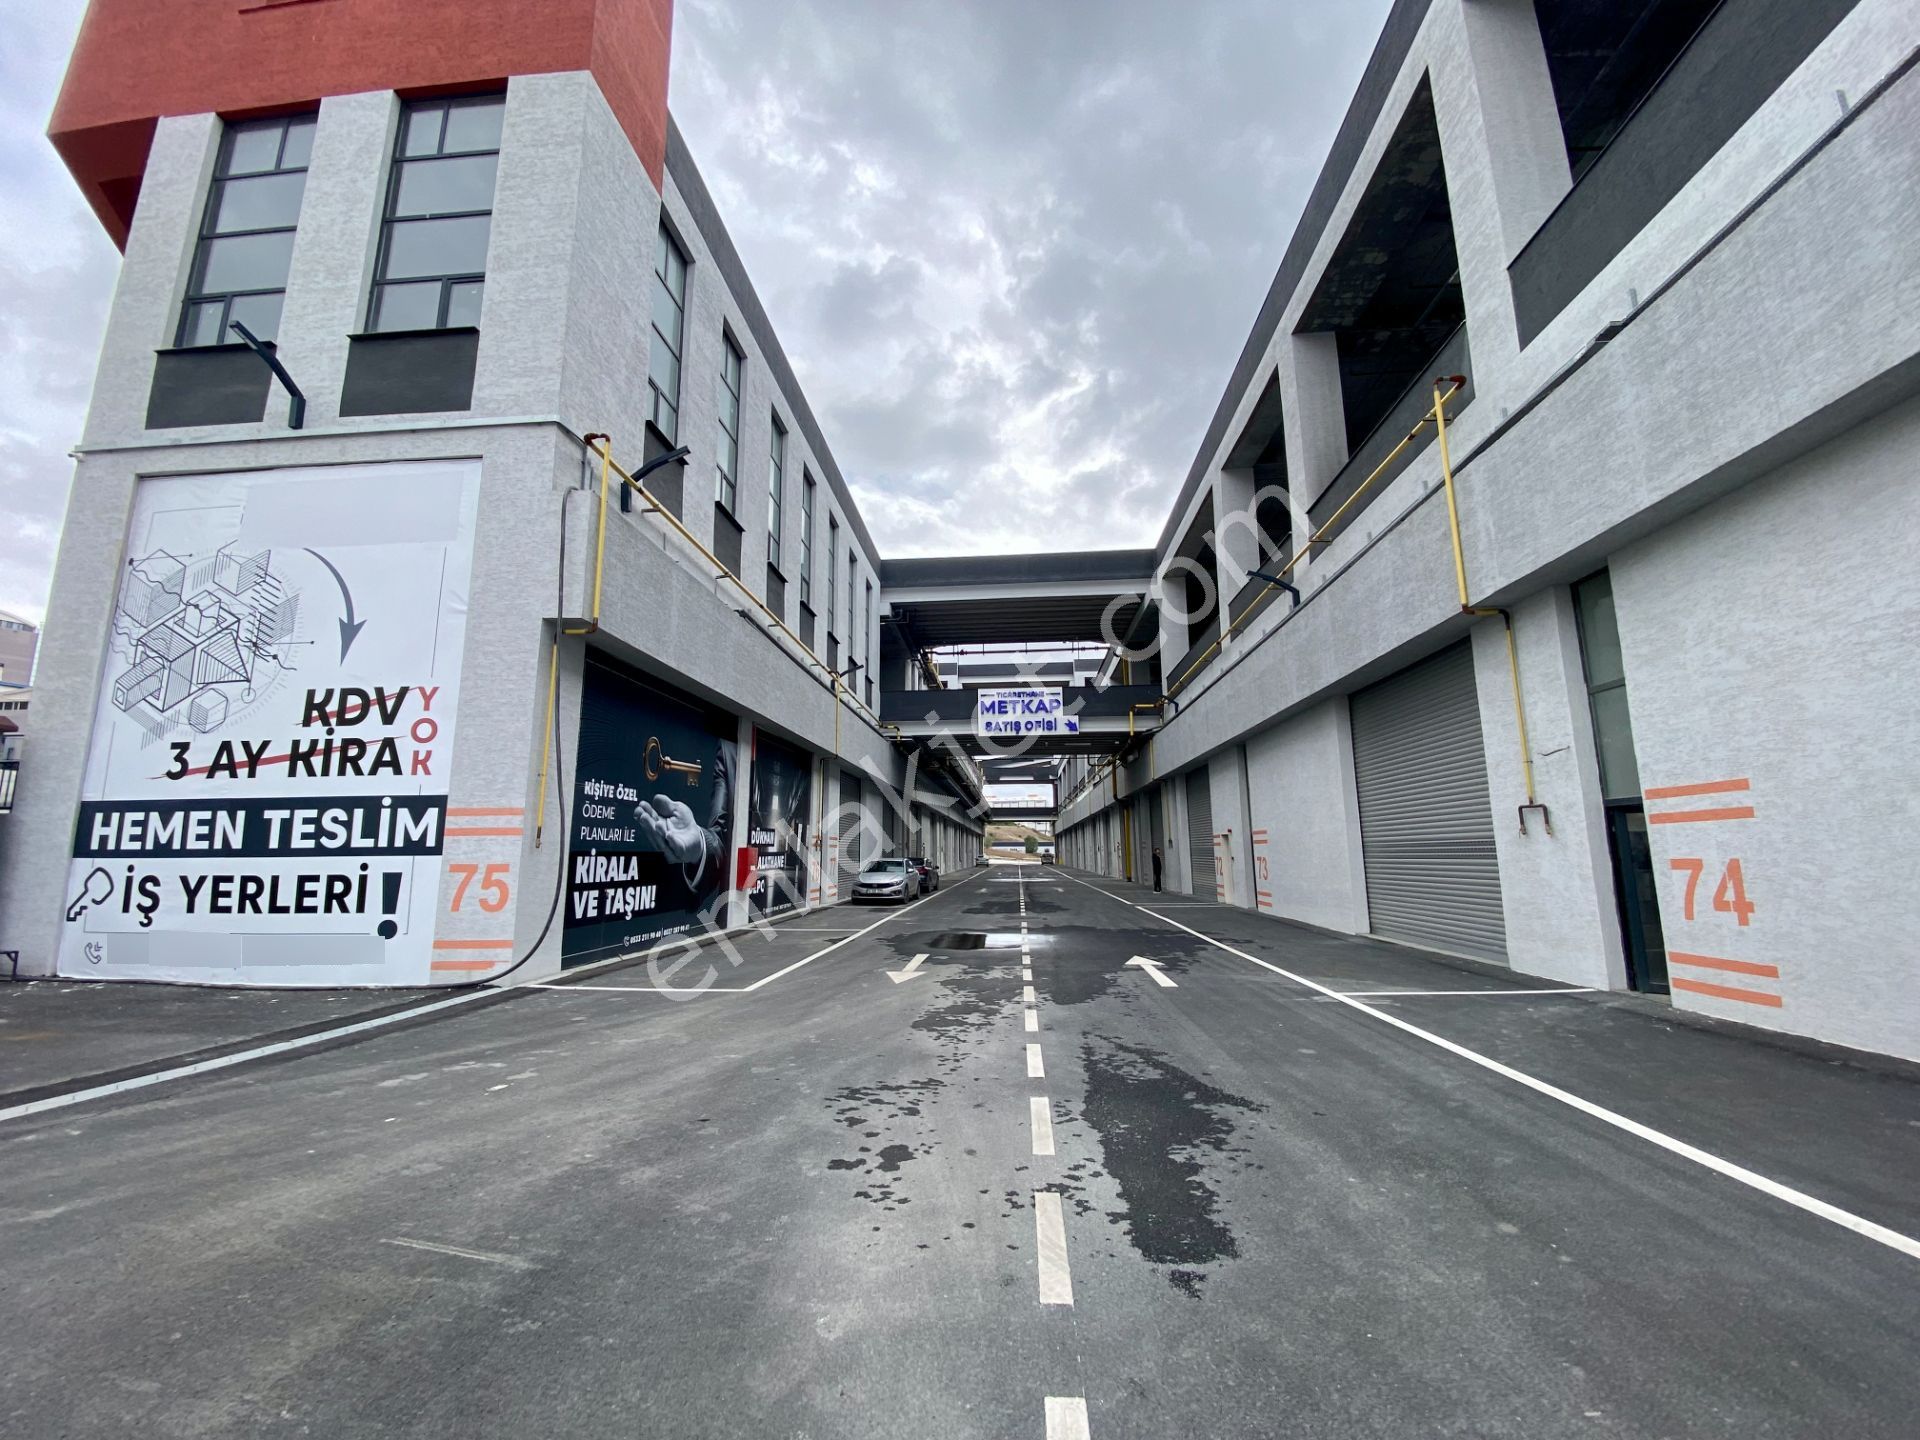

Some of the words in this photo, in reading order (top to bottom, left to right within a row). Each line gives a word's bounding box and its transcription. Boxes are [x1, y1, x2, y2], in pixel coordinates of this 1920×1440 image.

[302, 686, 410, 728] KDV
[980, 698, 1062, 715] METKAP
[985, 721, 1022, 735] SATIŞ
[1024, 717, 1058, 732] OFİSİ
[166, 741, 191, 780] 3
[206, 740, 271, 779] AY
[287, 727, 404, 778] KİRA
[584, 778, 615, 801] KİŞİYE
[616, 783, 638, 802] ÖZEL
[90, 809, 246, 851] HEMEN
[263, 796, 439, 849] TESLİM
[582, 800, 616, 820] ÖDEME
[580, 826, 622, 842] PLANLARI
[623, 826, 636, 842] İLE
[574, 847, 639, 884] KİRALA
[1256, 856, 1269, 881] 73
[121, 864, 162, 928] İŞ
[448, 863, 511, 913] 75
[573, 889, 599, 920] VE
[604, 884, 657, 921] TAŞIN!
[1668, 857, 1756, 927] 74
